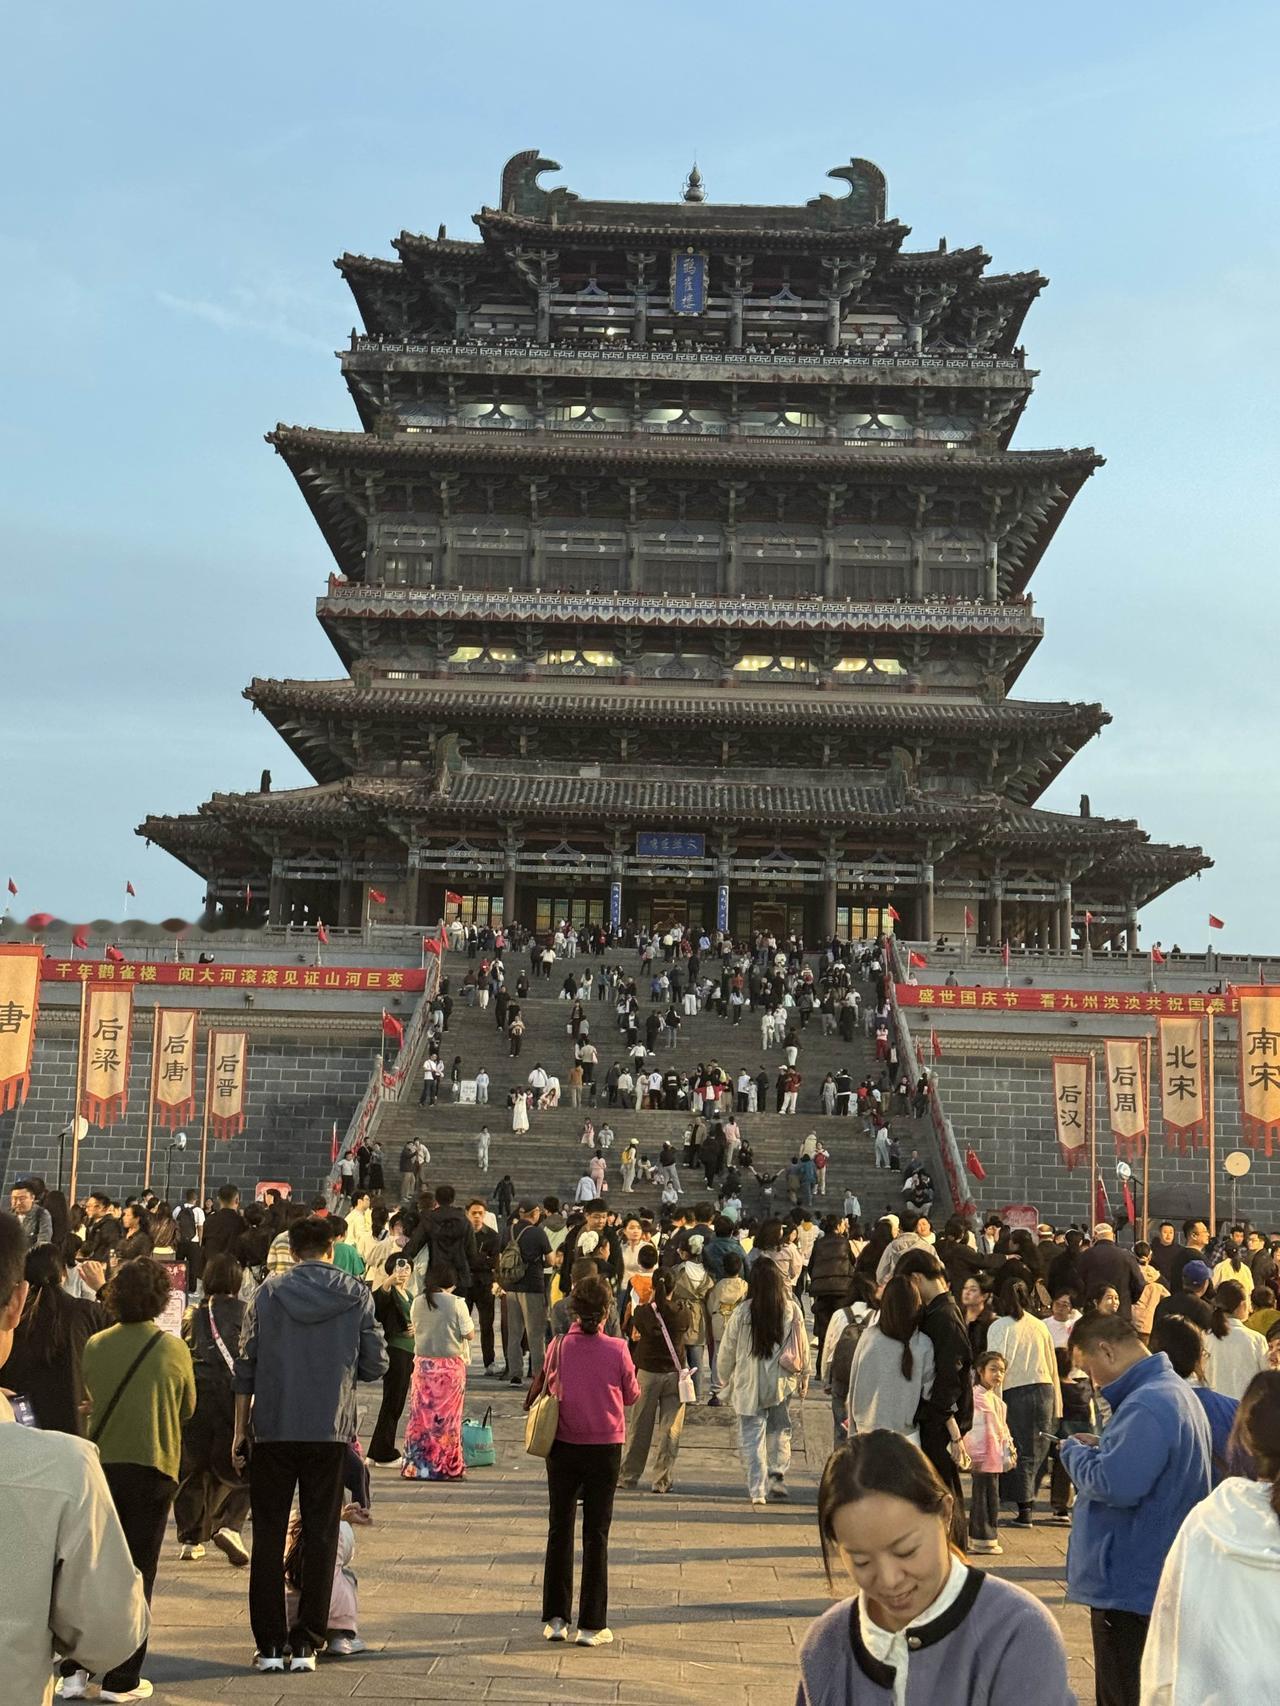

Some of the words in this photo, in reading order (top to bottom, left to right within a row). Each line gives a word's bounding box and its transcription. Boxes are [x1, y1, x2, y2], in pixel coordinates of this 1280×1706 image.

[56, 963, 157, 981] 千年鹳雀楼
[178, 967, 404, 987] 阅大河滚滚见证山河巨变
[918, 989, 1019, 1007] 盛世国庆节
[90, 1017, 124, 1073] 后梁
[162, 1033, 189, 1082] 后唐
[1247, 1027, 1280, 1091] 南宋
[216, 1054, 240, 1097] 后晋
[1112, 1066, 1137, 1113] 后周
[1166, 1045, 1198, 1100] 北宋
[1058, 1085, 1082, 1128] 后汉
